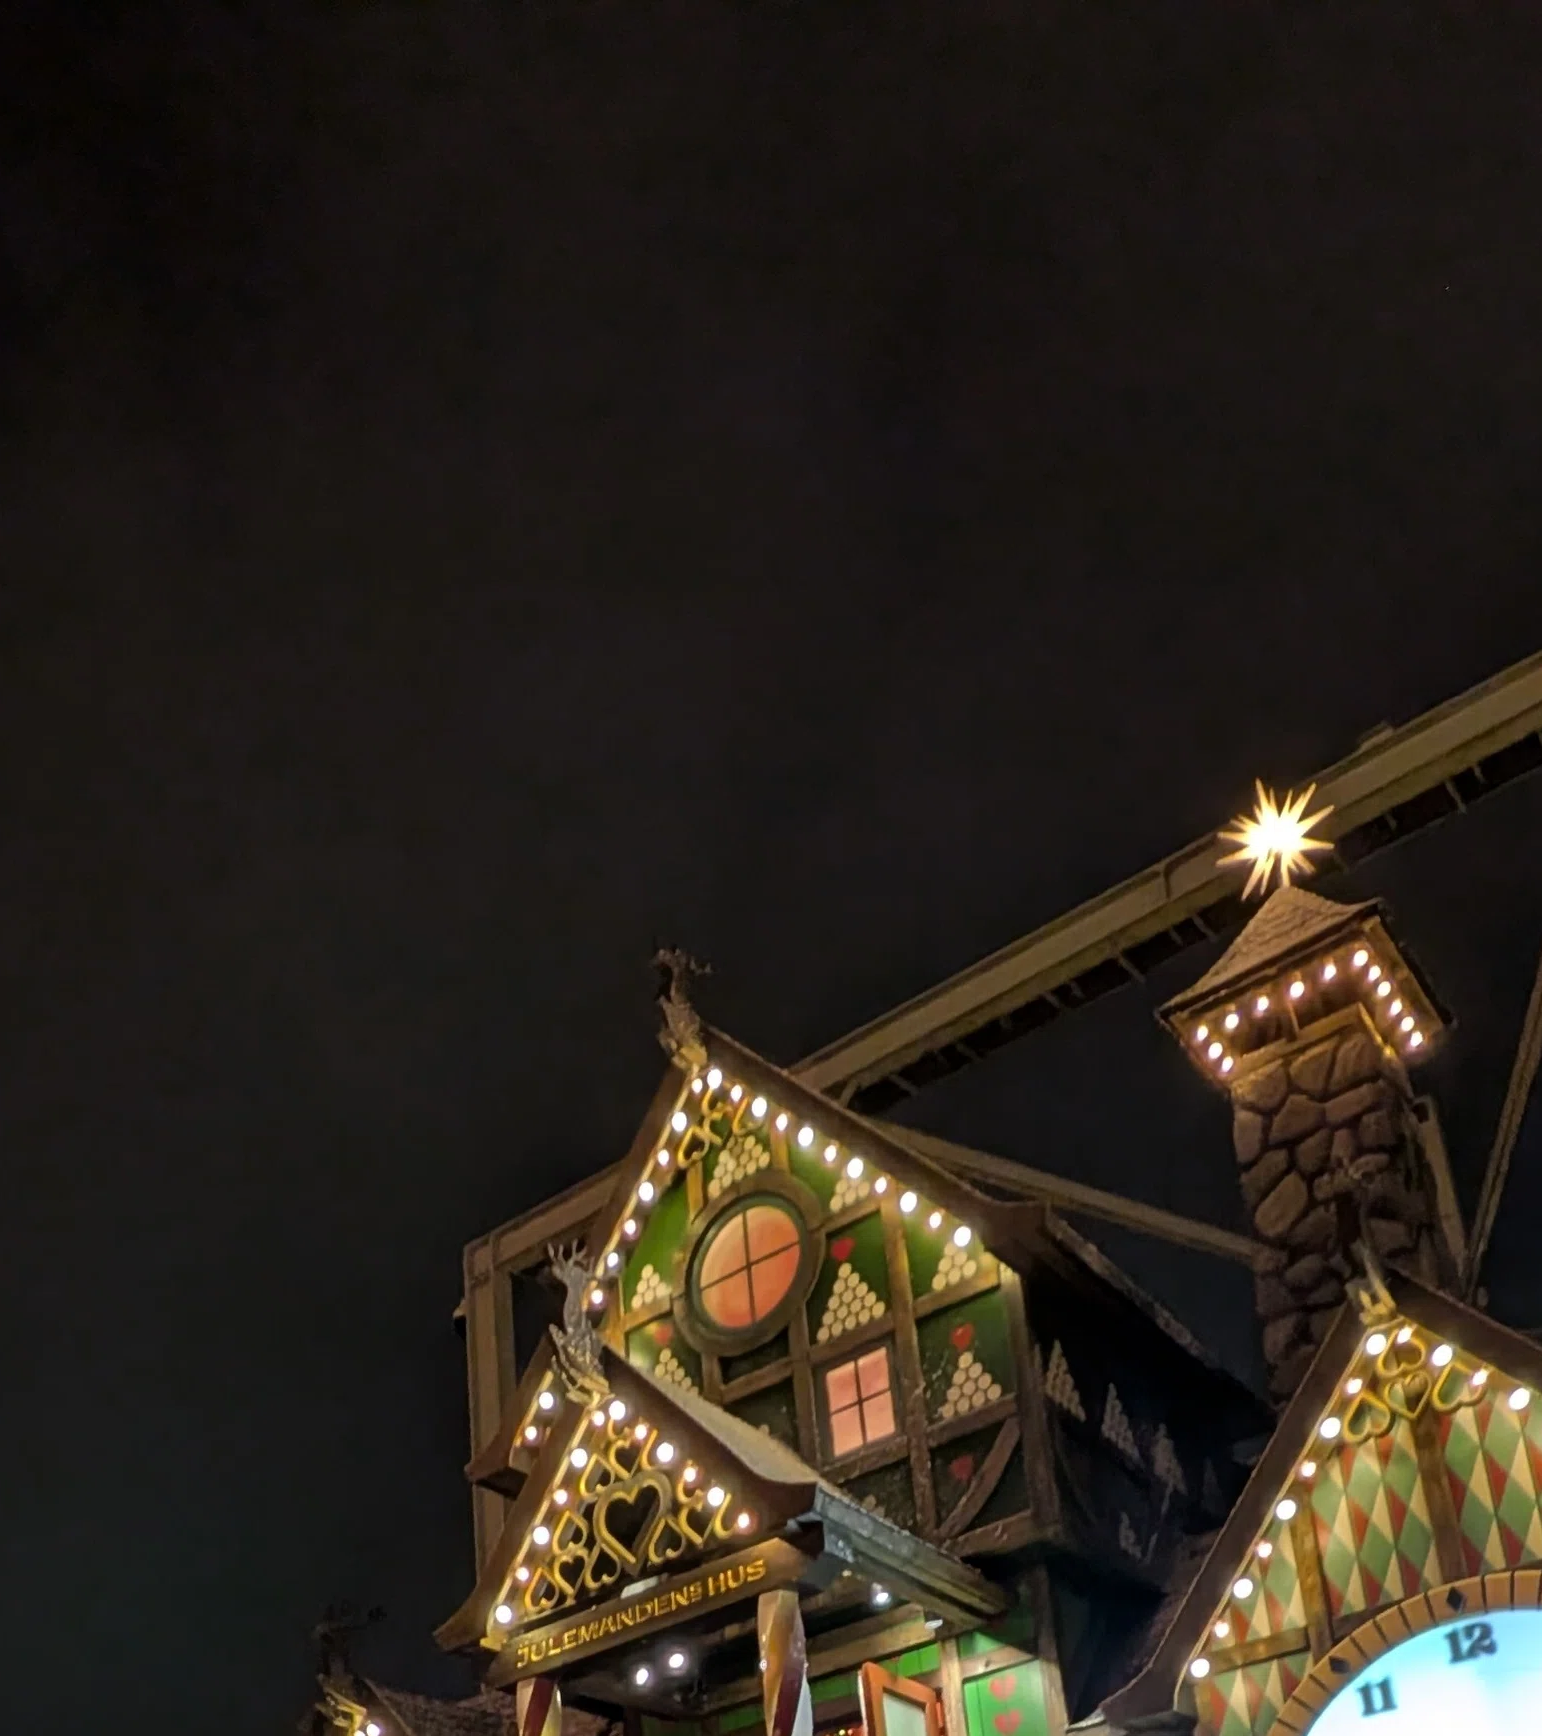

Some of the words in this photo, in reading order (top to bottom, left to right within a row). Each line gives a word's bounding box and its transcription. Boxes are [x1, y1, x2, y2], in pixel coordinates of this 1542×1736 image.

[516, 1581, 703, 1668] JULEMANDENS
[707, 1558, 767, 1597] HUS
[1444, 1621, 1498, 1664] 12
[1357, 1675, 1398, 1717] 11
